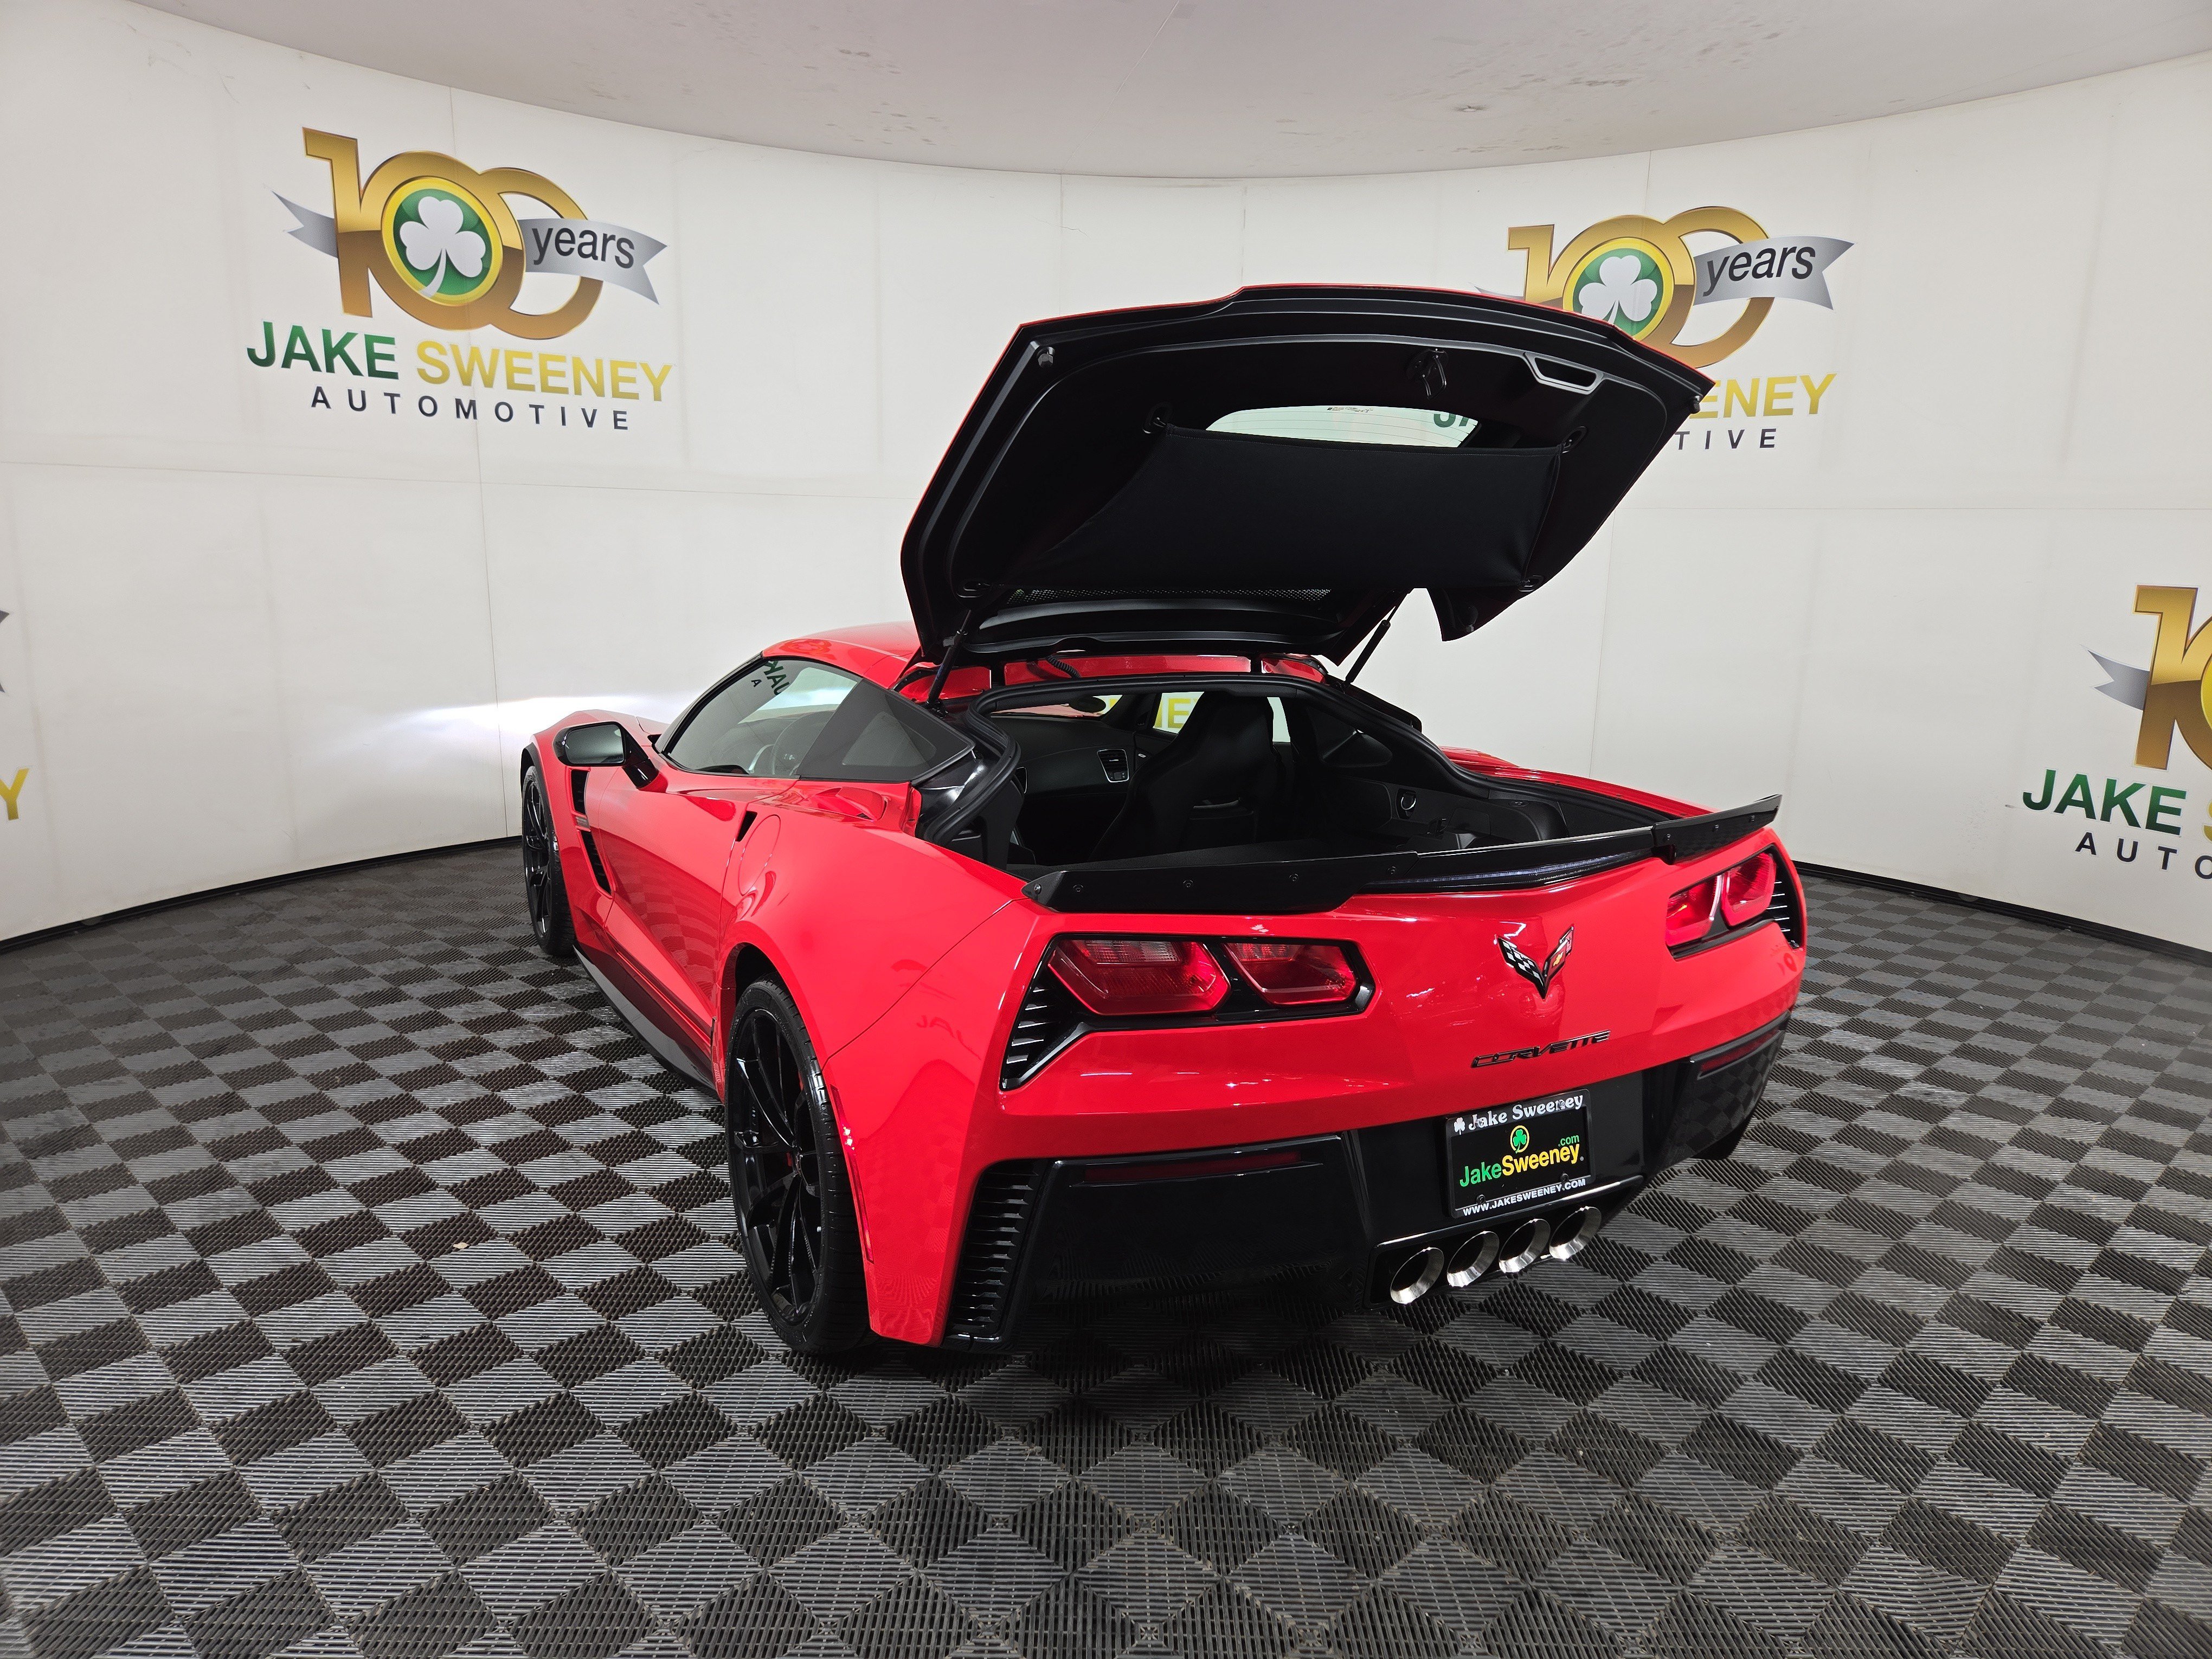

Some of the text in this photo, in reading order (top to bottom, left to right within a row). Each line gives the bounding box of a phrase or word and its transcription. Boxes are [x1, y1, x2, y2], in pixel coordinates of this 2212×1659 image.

[302, 127, 635, 340] 100 years
[1706, 245, 1816, 296] years
[247, 321, 672, 402] JAKE SWEENEY
[311, 385, 629, 430] AUTOMOTIVE
[2022, 769, 2187, 836] JAKE
[1471, 1030, 1611, 1068] CORVETTE
[1468, 1095, 1583, 1130] Jake Sweeney
[1558, 1134, 1580, 1147] .com
[1459, 1143, 1580, 1187] JakeSweeney
[1463, 1179, 1586, 1216] WWW.JAKESWEENEY.COM
